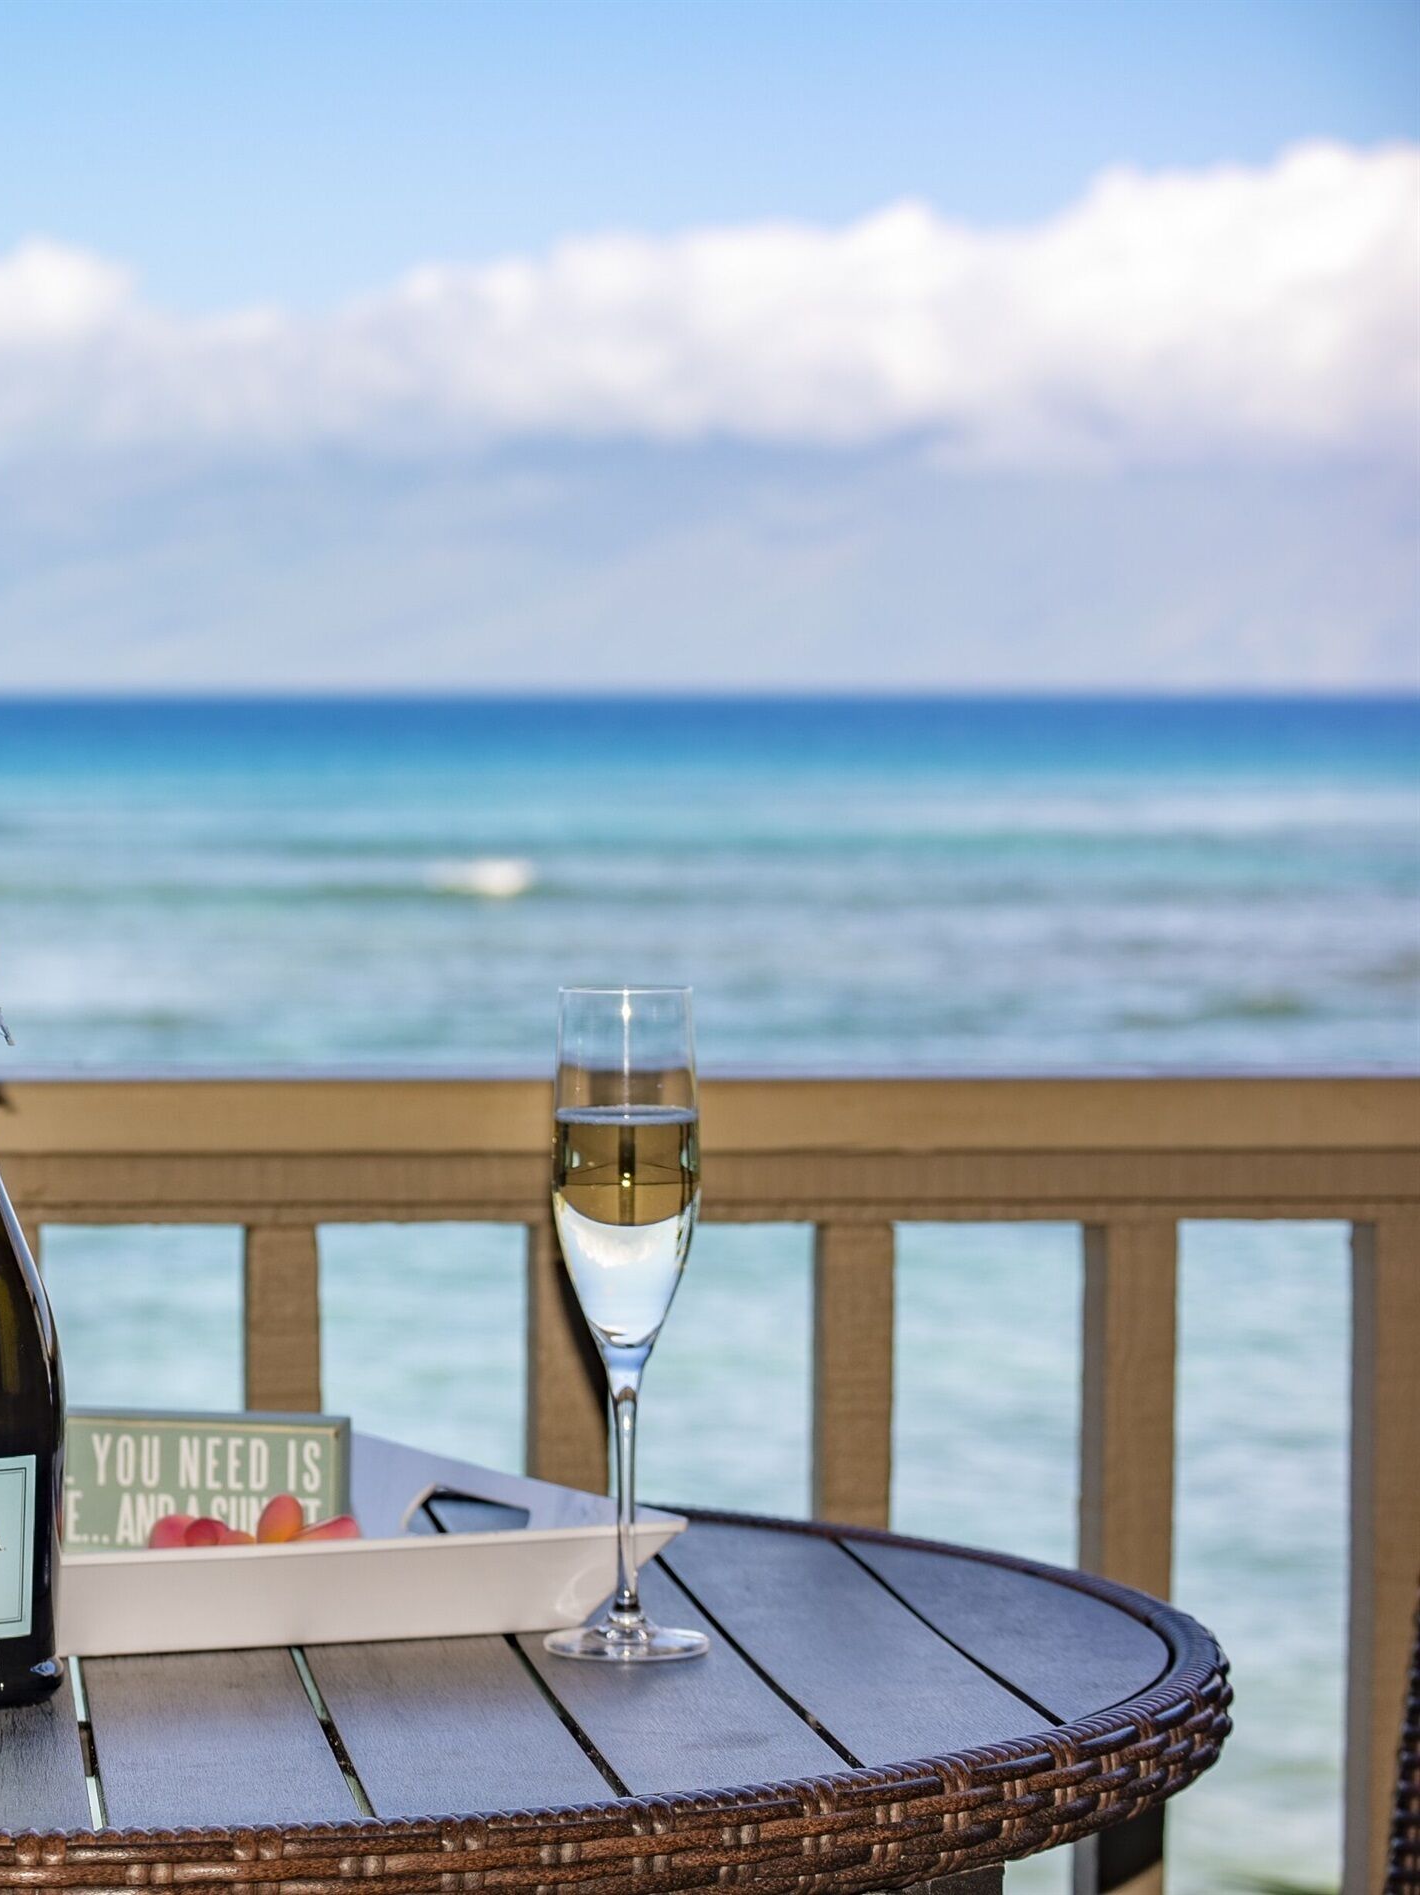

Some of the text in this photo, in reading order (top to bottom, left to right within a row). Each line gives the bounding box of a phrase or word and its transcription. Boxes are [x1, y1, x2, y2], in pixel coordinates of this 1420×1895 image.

[91, 1432, 322, 1493] YOU NEED IS
